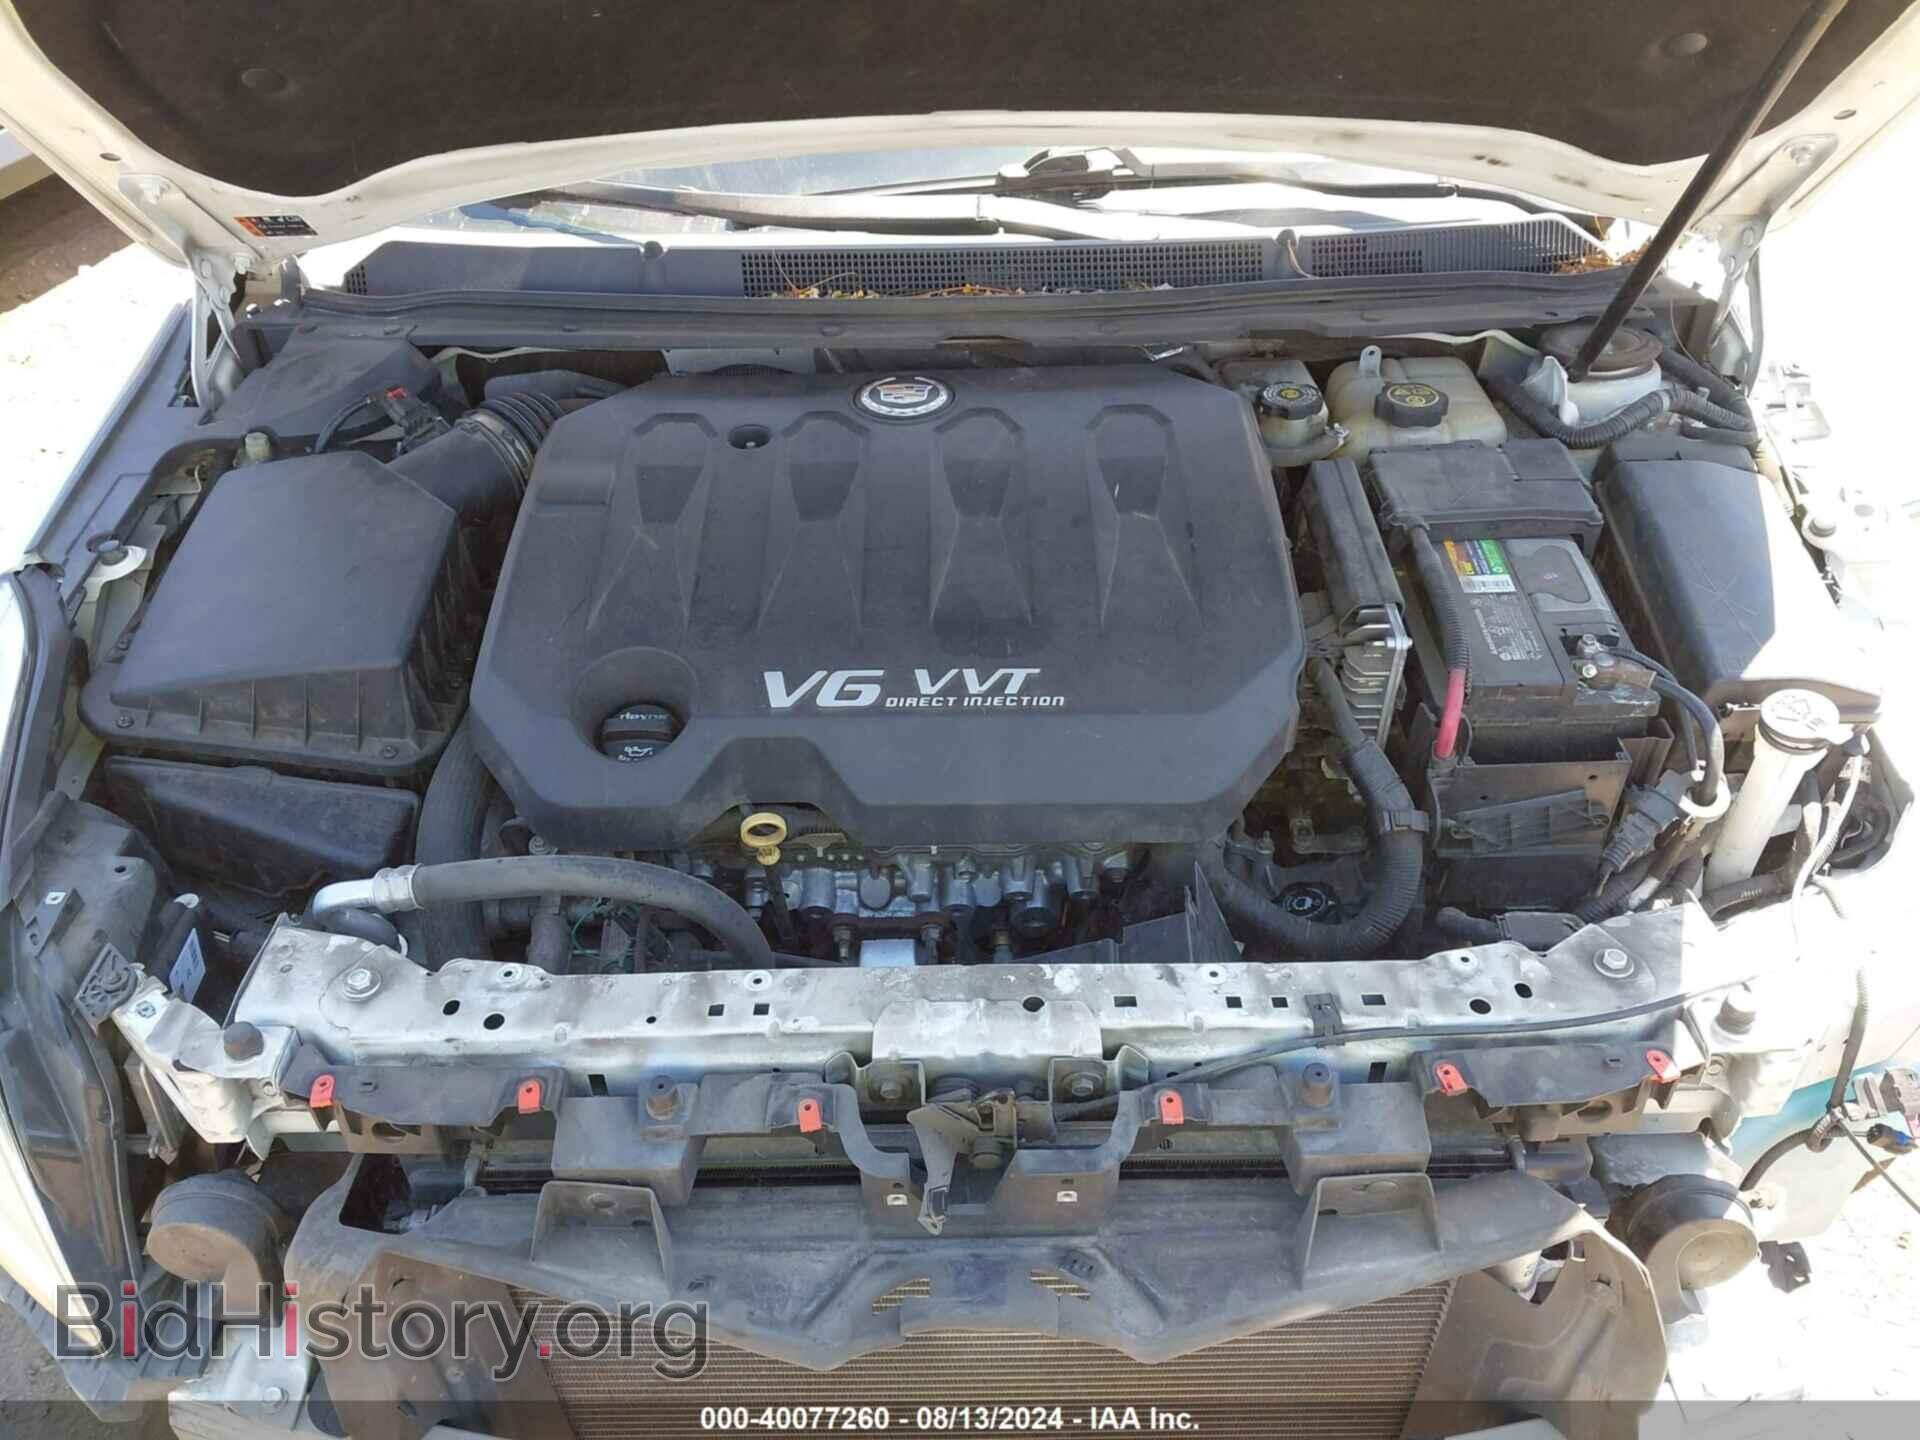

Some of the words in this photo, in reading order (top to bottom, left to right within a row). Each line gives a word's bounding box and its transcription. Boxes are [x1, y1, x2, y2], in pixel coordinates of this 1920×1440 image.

[763, 670, 885, 708] V6
[914, 668, 1041, 695] VVT
[885, 696, 958, 708] DIRECT
[963, 695, 1065, 707] INJECTION
